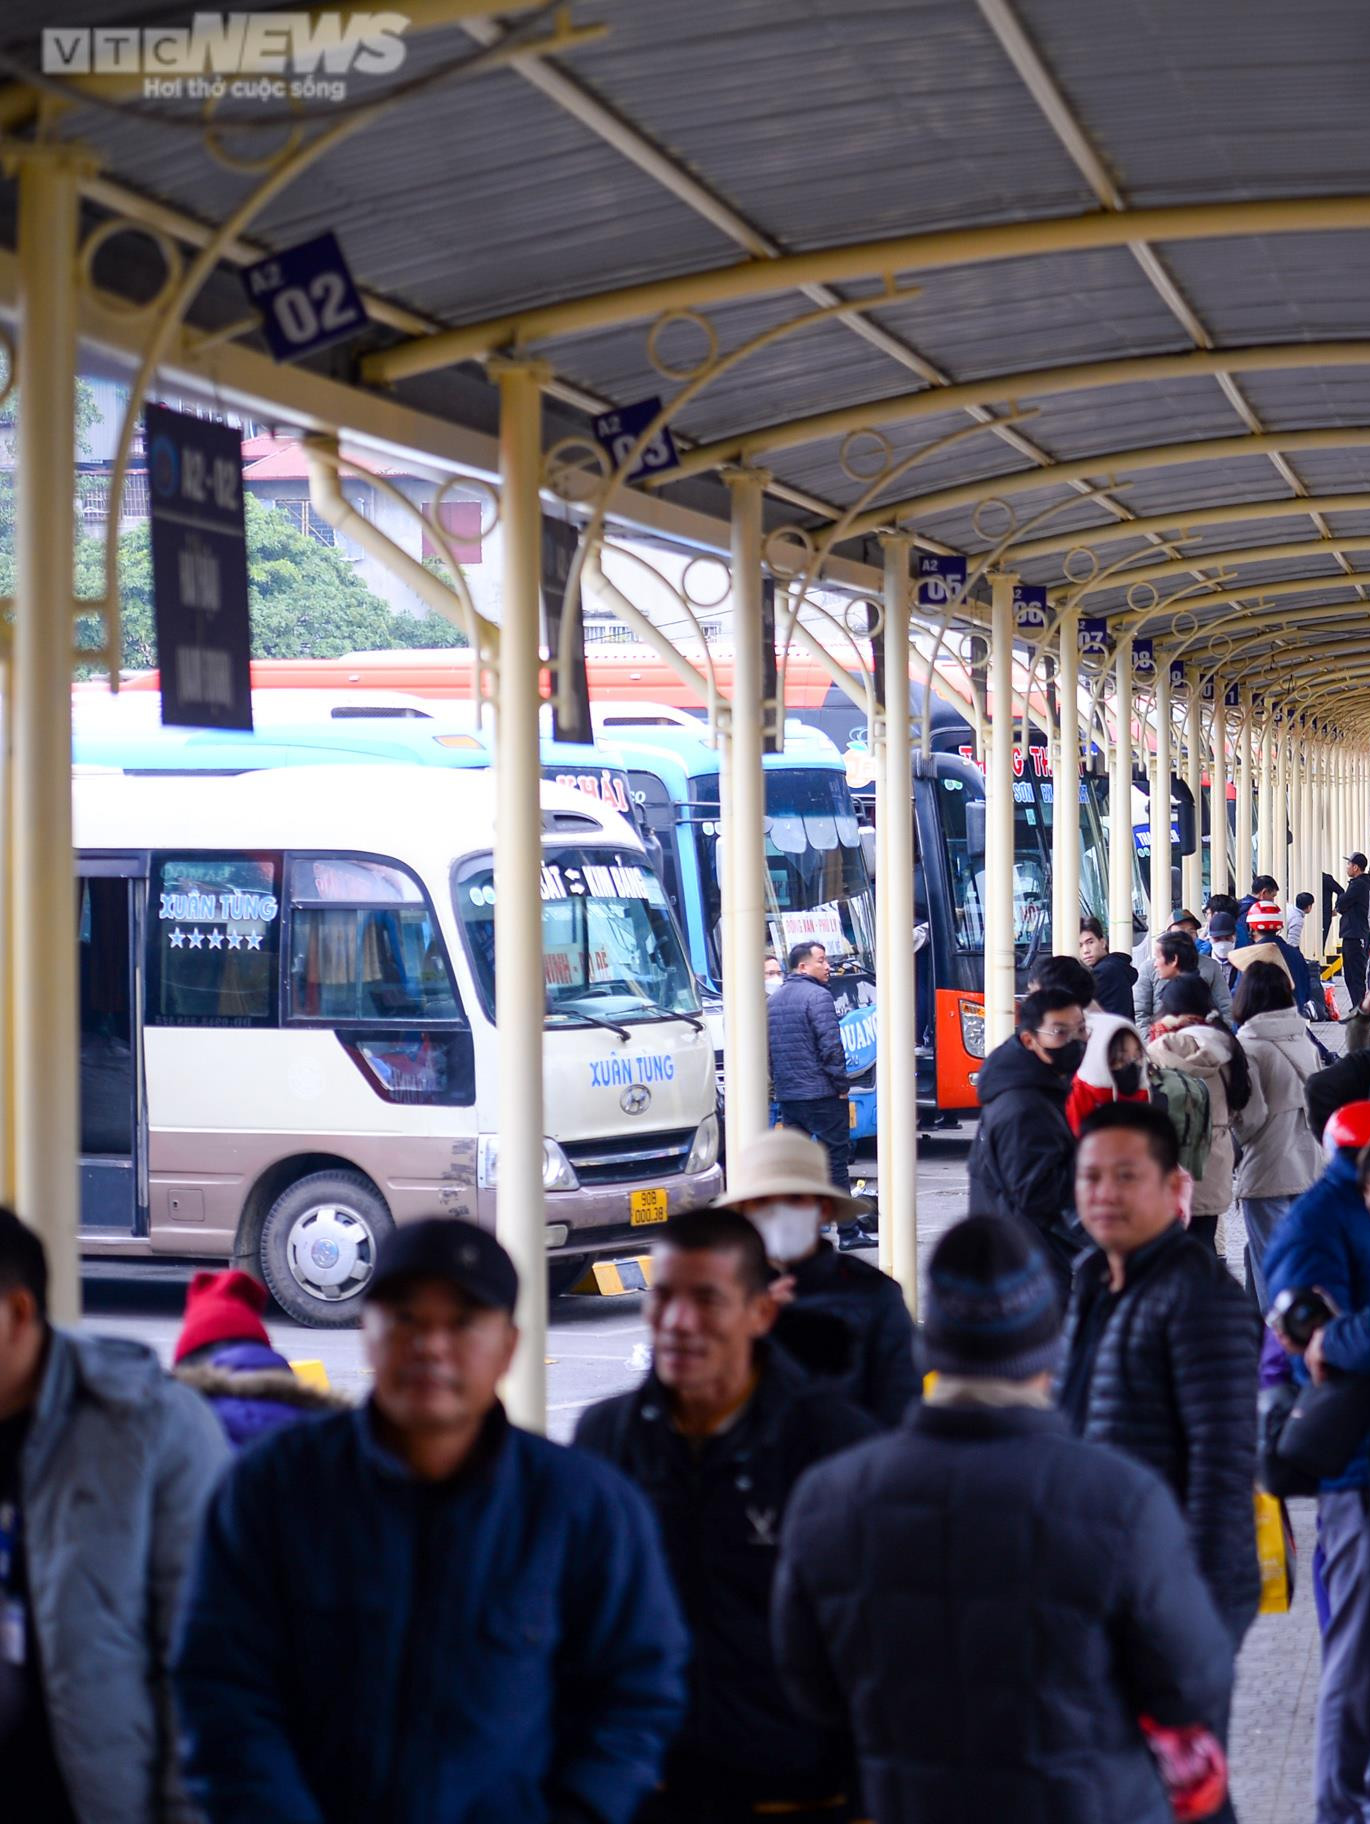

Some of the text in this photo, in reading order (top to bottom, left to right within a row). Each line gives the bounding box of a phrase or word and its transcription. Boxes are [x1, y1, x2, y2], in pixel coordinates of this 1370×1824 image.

[273, 272, 357, 343] 02
[922, 560, 938, 571] A2
[159, 889, 278, 922] XUÂN TÙNG
[590, 1050, 633, 1087] XUÂN
